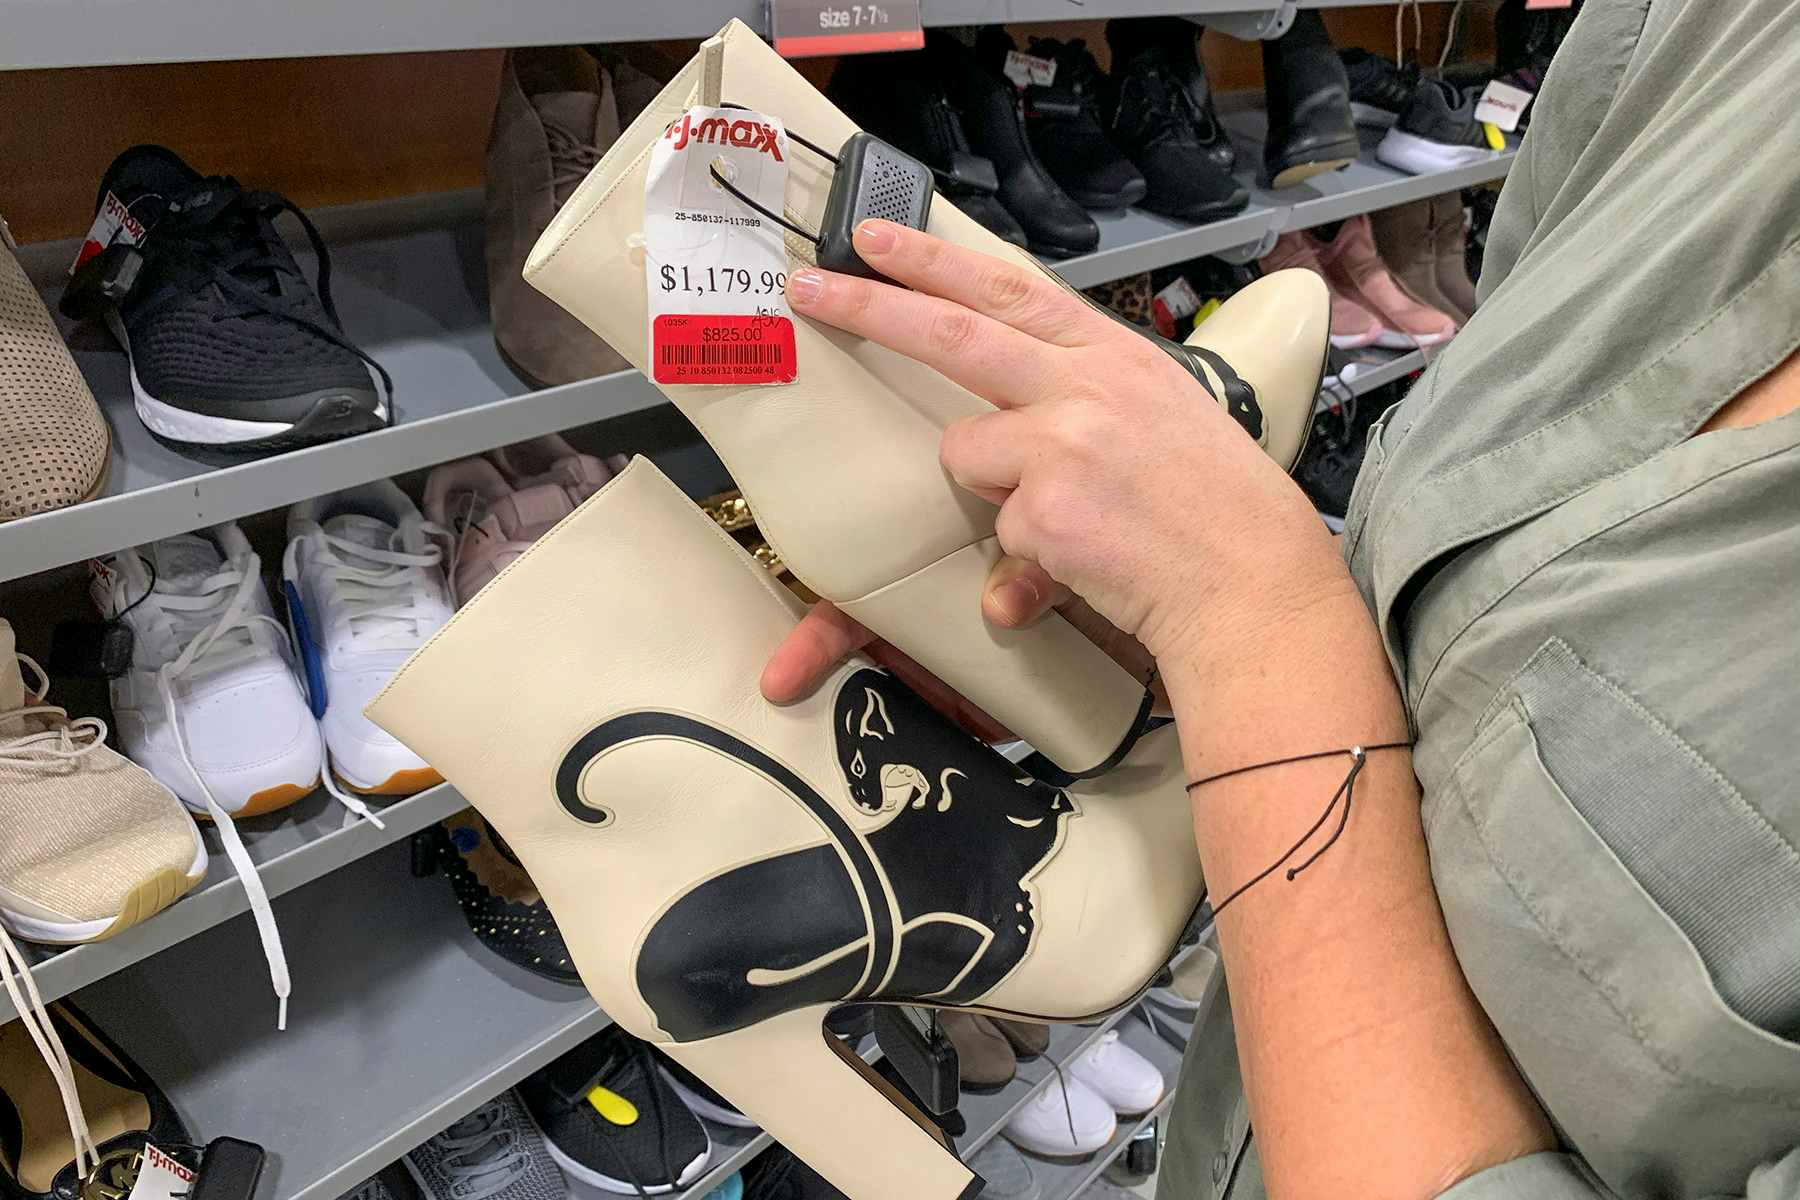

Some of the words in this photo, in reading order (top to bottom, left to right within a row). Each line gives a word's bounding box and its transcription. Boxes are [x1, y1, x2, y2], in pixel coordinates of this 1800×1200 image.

[819, 6, 850, 28] size
[660, 263, 787, 297] $1,179.99
[702, 326, 763, 343] $825.00
[676, 366, 687, 376] 25
